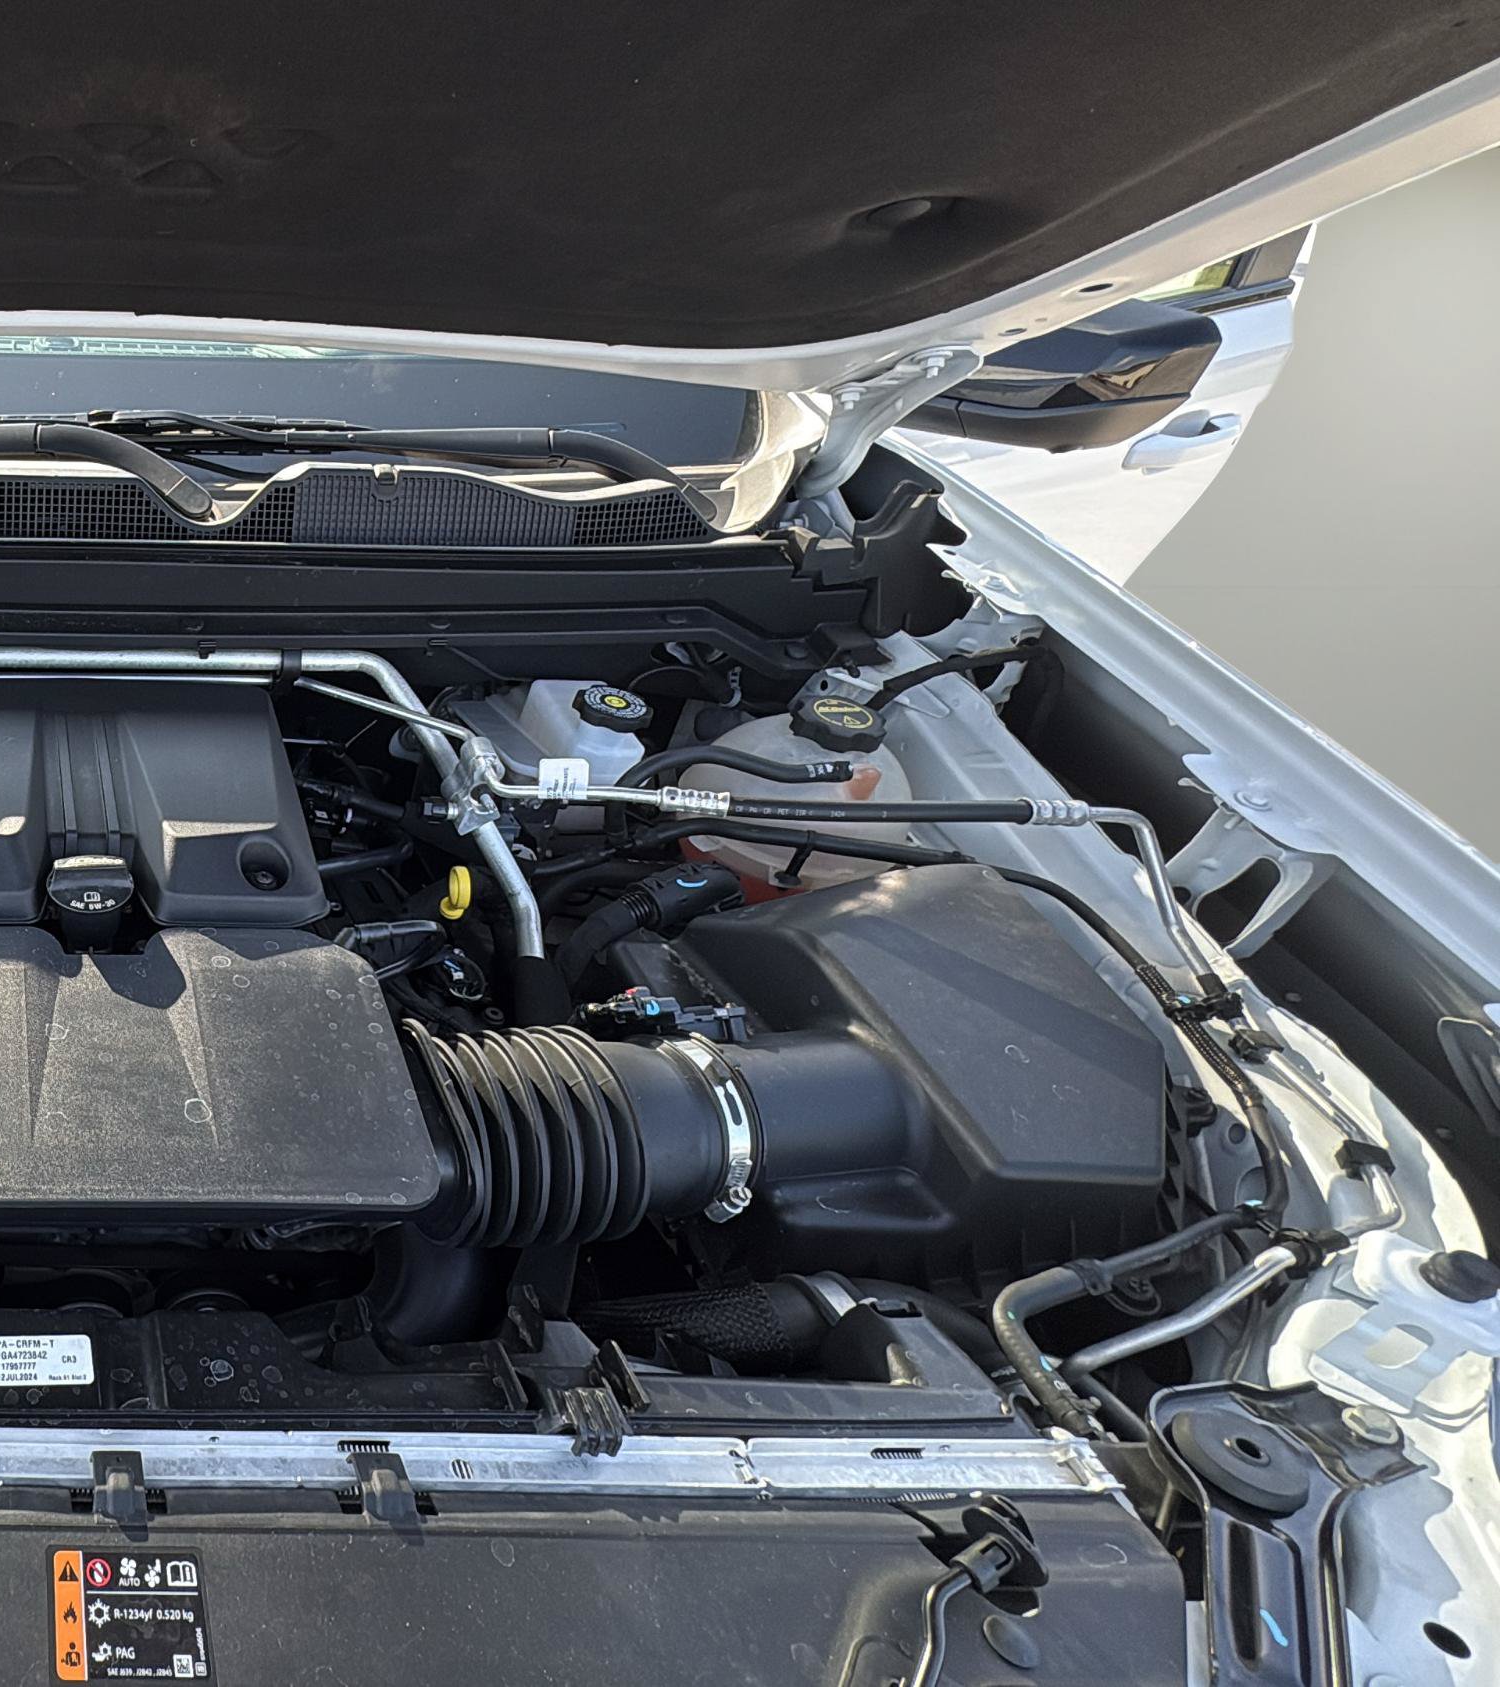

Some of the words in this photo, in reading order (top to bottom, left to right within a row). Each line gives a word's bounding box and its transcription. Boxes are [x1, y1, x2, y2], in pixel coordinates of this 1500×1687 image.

[70, 899, 85, 909] SAE
[61, 1354, 77, 1364] CR3
[118, 1577, 141, 1587] AUTO
[113, 1607, 154, 1622] R-1234yf
[156, 1608, 181, 1620] 0.520
[182, 1609, 195, 1623] kg
[115, 1645, 136, 1659] PAG
